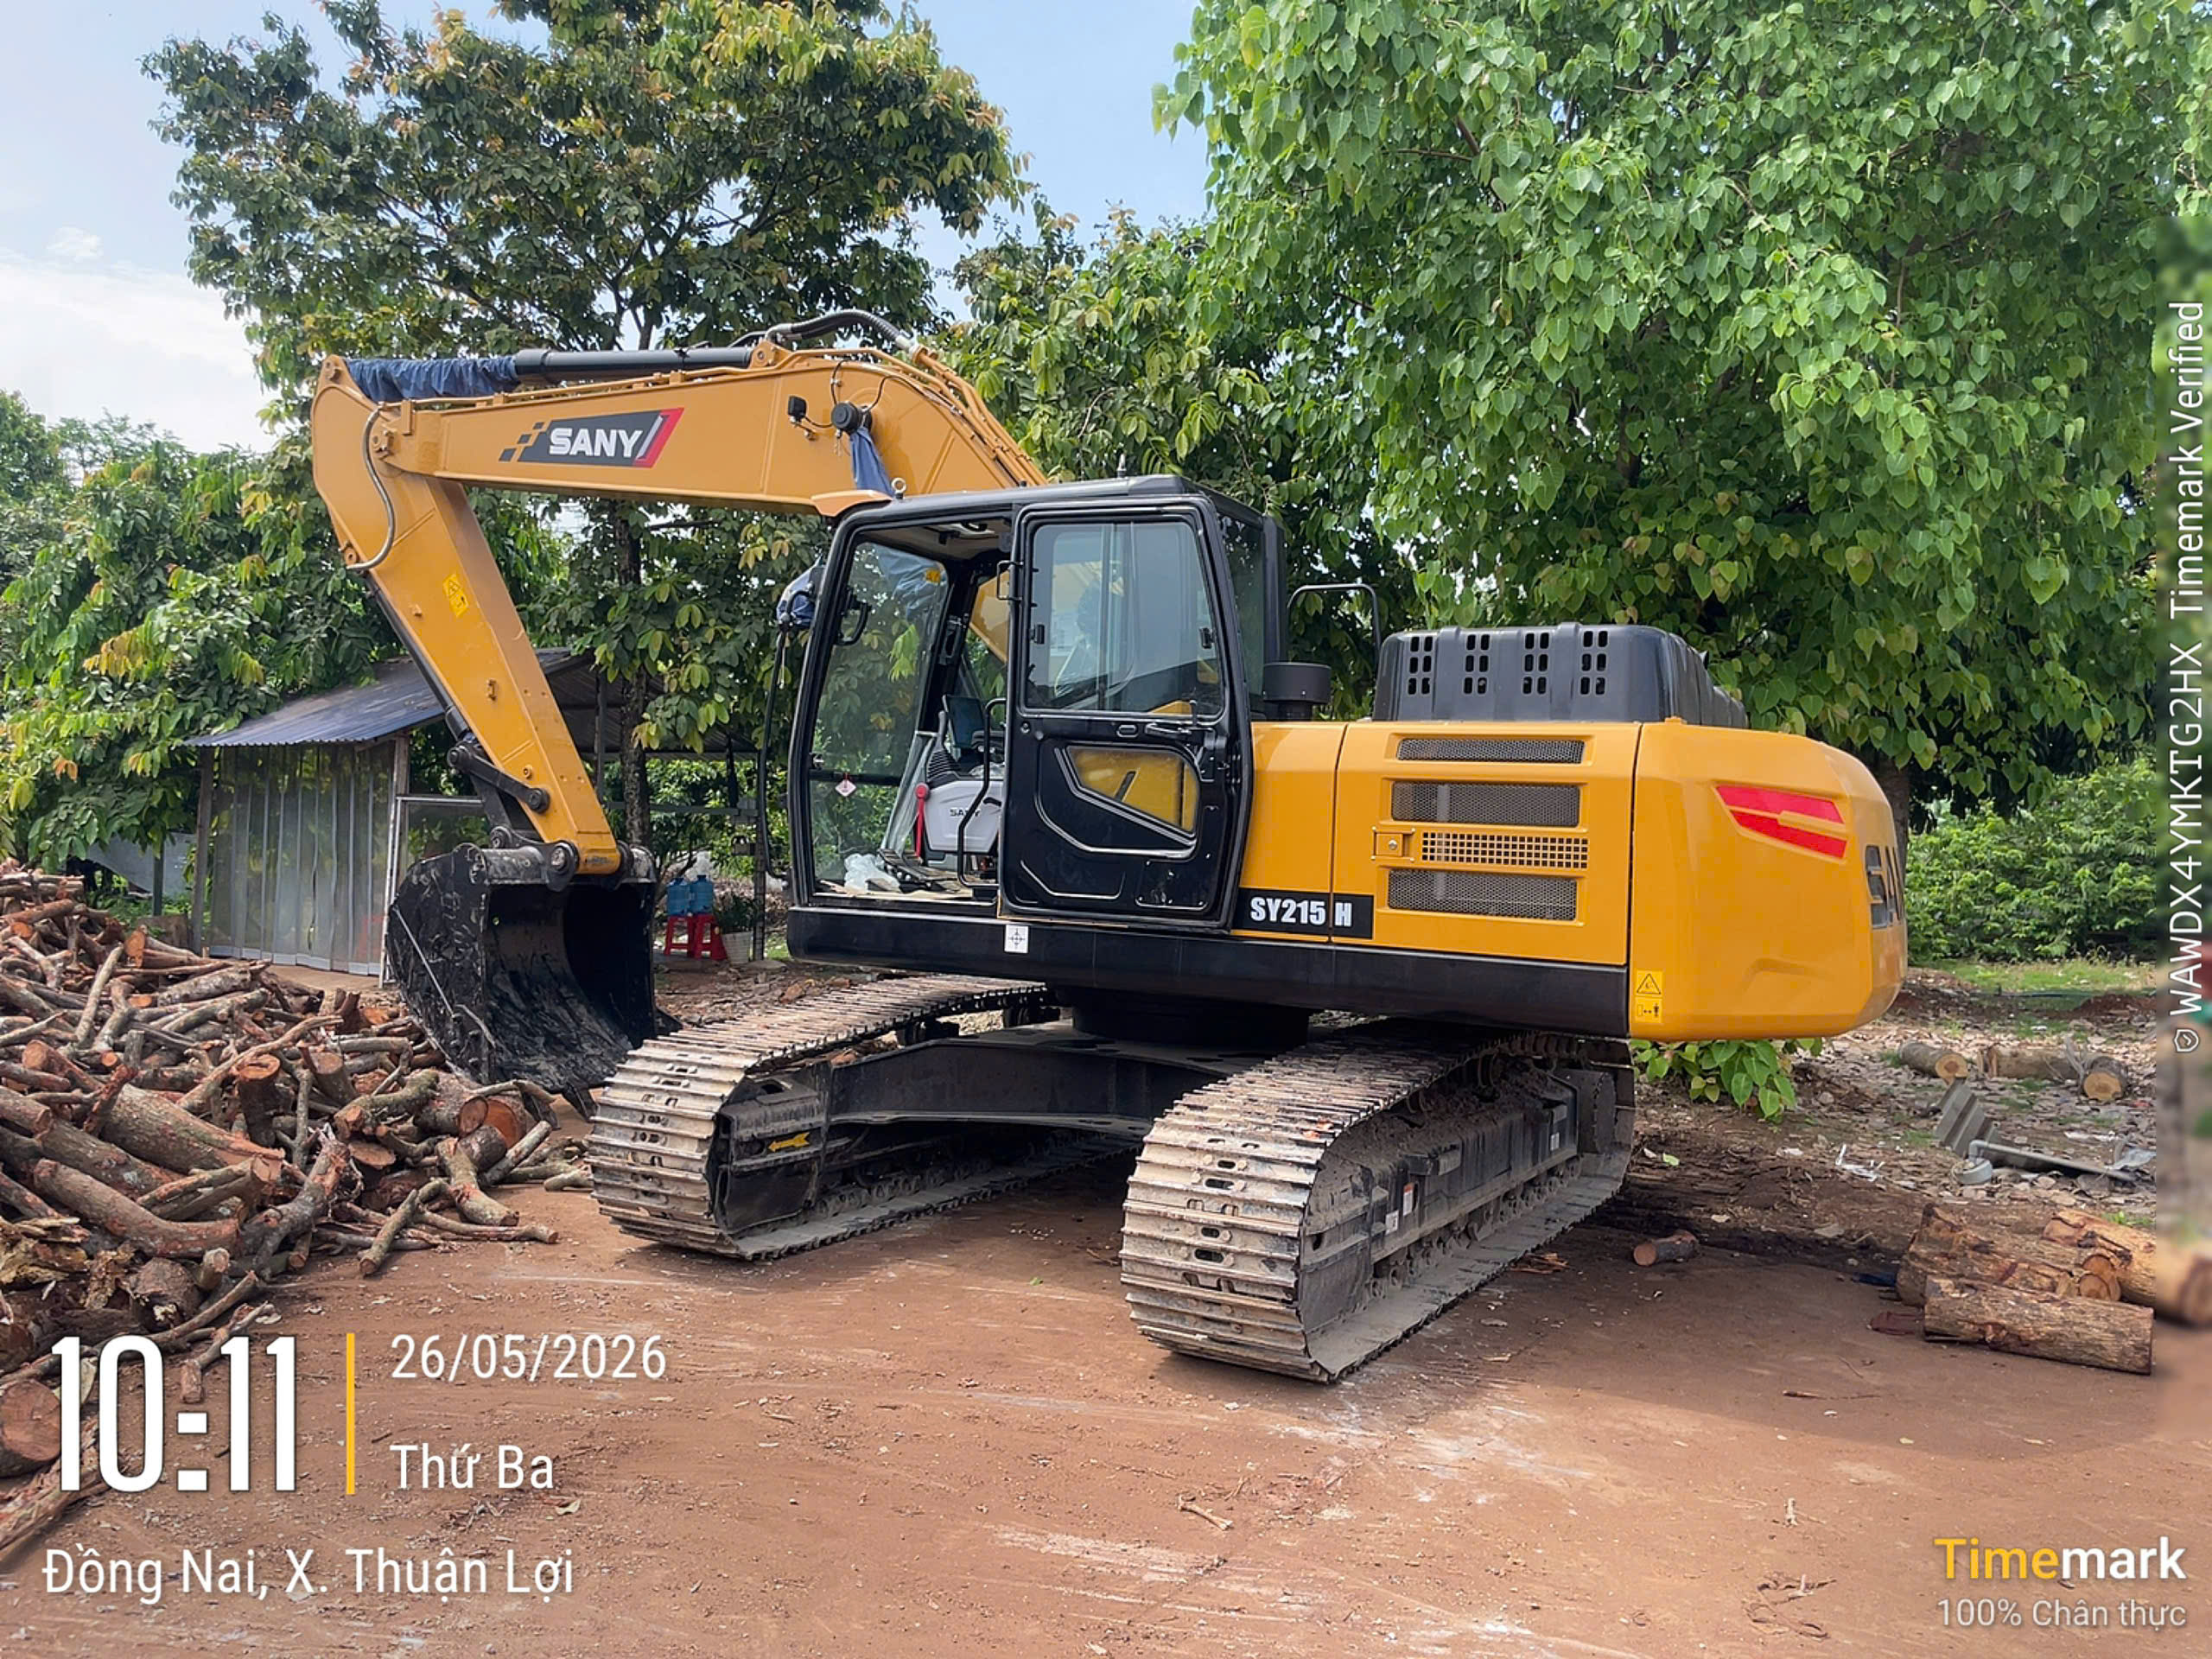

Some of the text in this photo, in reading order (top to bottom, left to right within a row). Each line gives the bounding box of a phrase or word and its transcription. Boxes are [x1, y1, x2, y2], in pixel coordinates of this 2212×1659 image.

[549, 427, 643, 458] SANY
[950, 809, 981, 817] SAY
[1250, 896, 1353, 927] SY215 H
